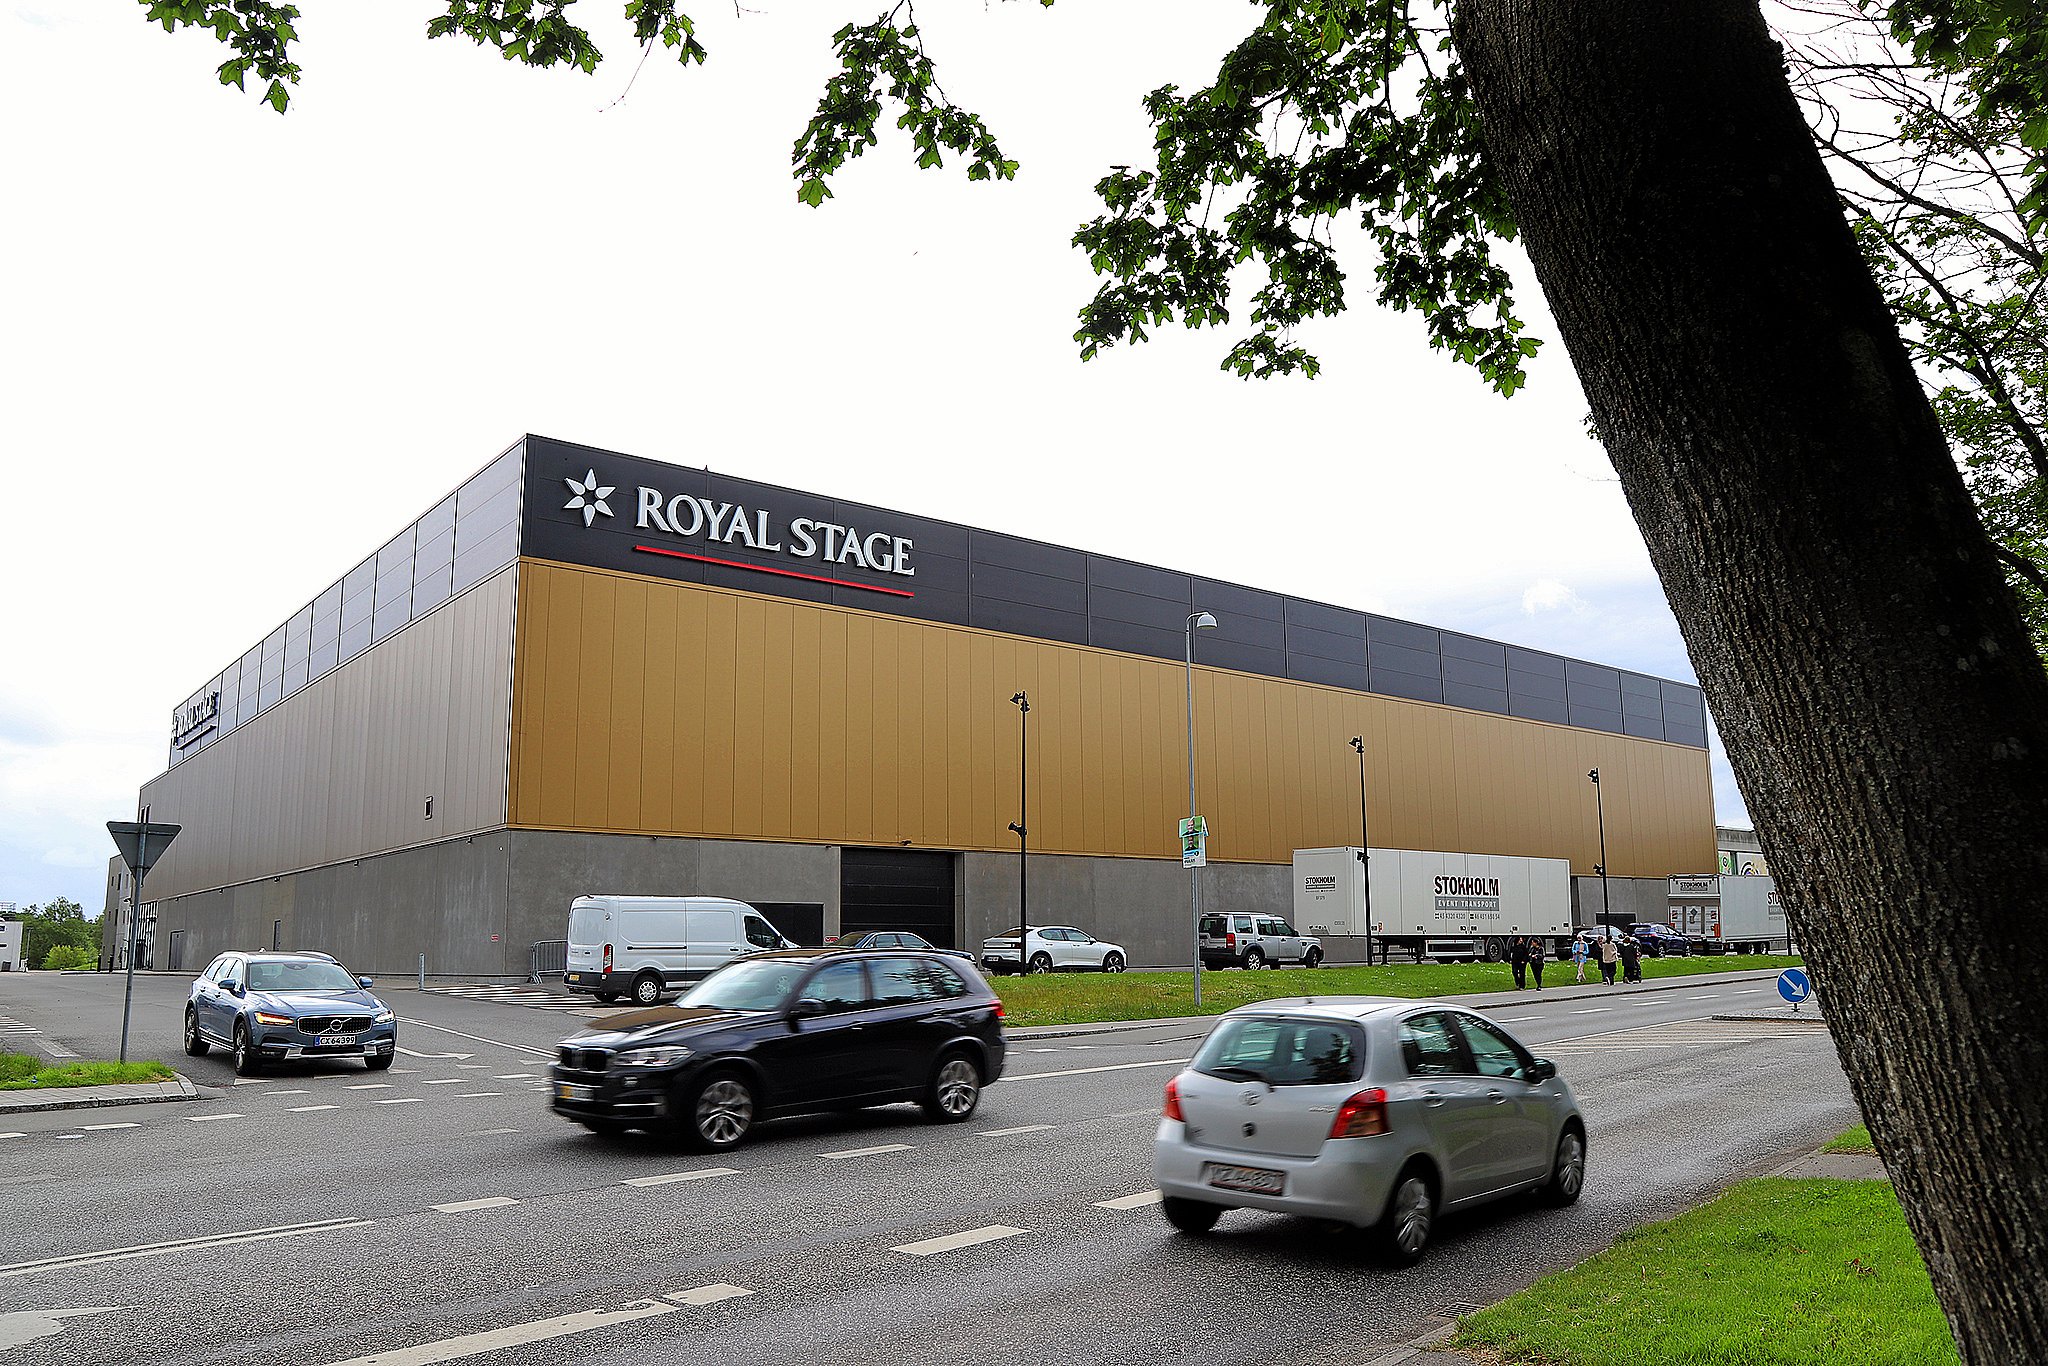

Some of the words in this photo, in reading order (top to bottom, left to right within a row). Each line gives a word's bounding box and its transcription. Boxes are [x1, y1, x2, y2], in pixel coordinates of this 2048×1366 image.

[635, 485, 781, 552] ROYAL
[789, 517, 915, 576] STAGE
[1305, 876, 1336, 884] STOKHOLM
[1434, 875, 1500, 897] STOKHOLM
[1438, 899, 1459, 907] EVENT
[1461, 900, 1497, 908] TRANSPORT
